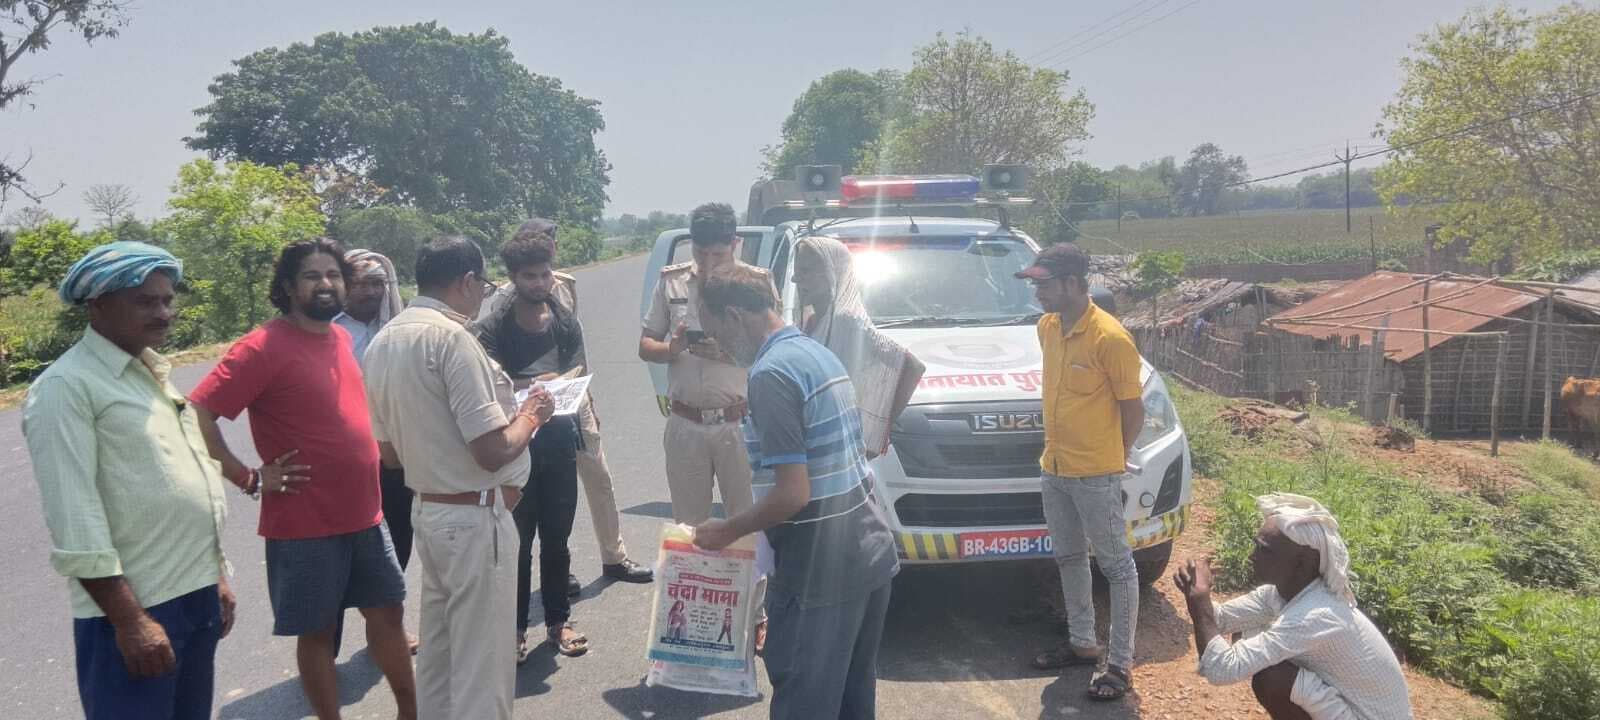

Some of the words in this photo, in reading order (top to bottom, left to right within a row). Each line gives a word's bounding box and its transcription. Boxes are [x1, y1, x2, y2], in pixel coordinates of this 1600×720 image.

[974, 414, 1046, 430] ISUZU
[667, 579, 698, 601] चंदा
[702, 587, 740, 607] मामा
